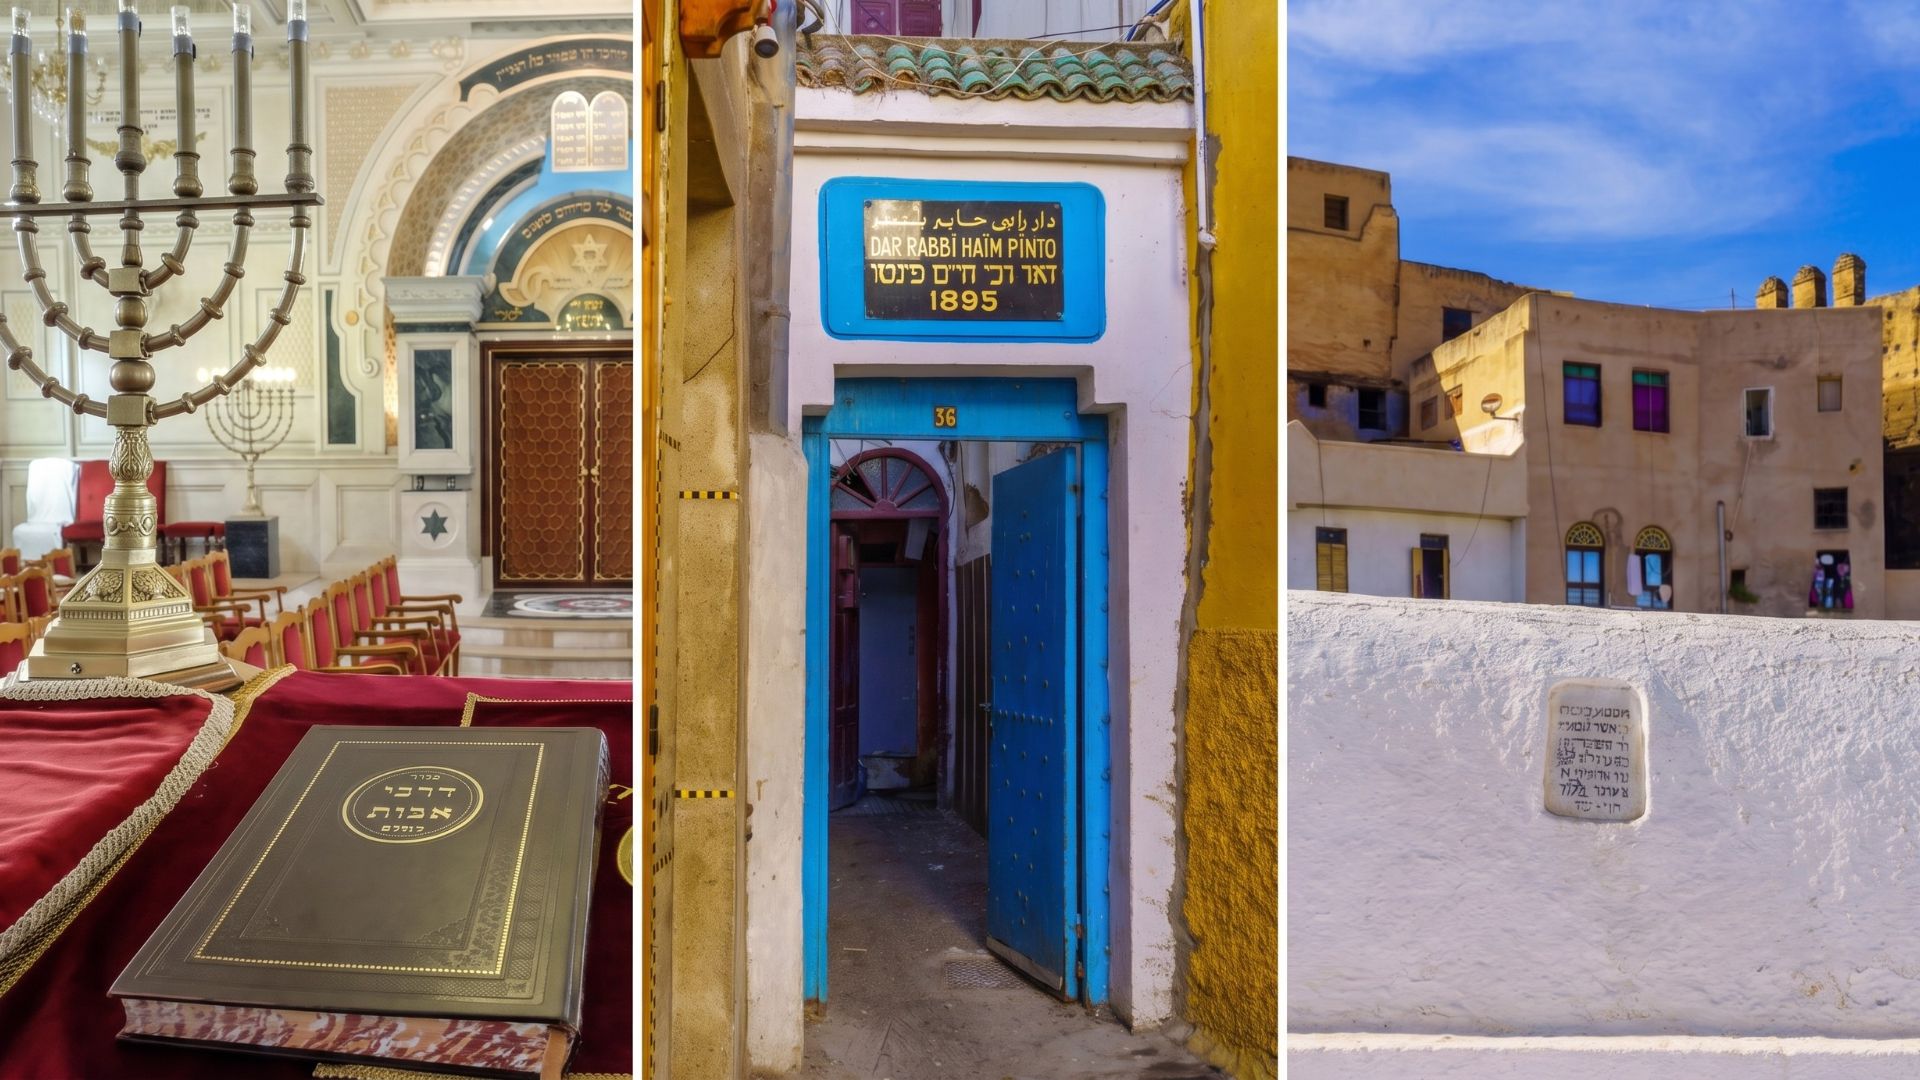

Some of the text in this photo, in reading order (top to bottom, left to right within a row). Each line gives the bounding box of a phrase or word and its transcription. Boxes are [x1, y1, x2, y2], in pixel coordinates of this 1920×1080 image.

[1031, 209, 1056, 232] دار
[871, 236, 902, 257] DAR
[961, 232, 1002, 258] HAÏM
[930, 290, 998, 312] 1895
[935, 407, 956, 427] 36
[366, 806, 453, 820] אבות
